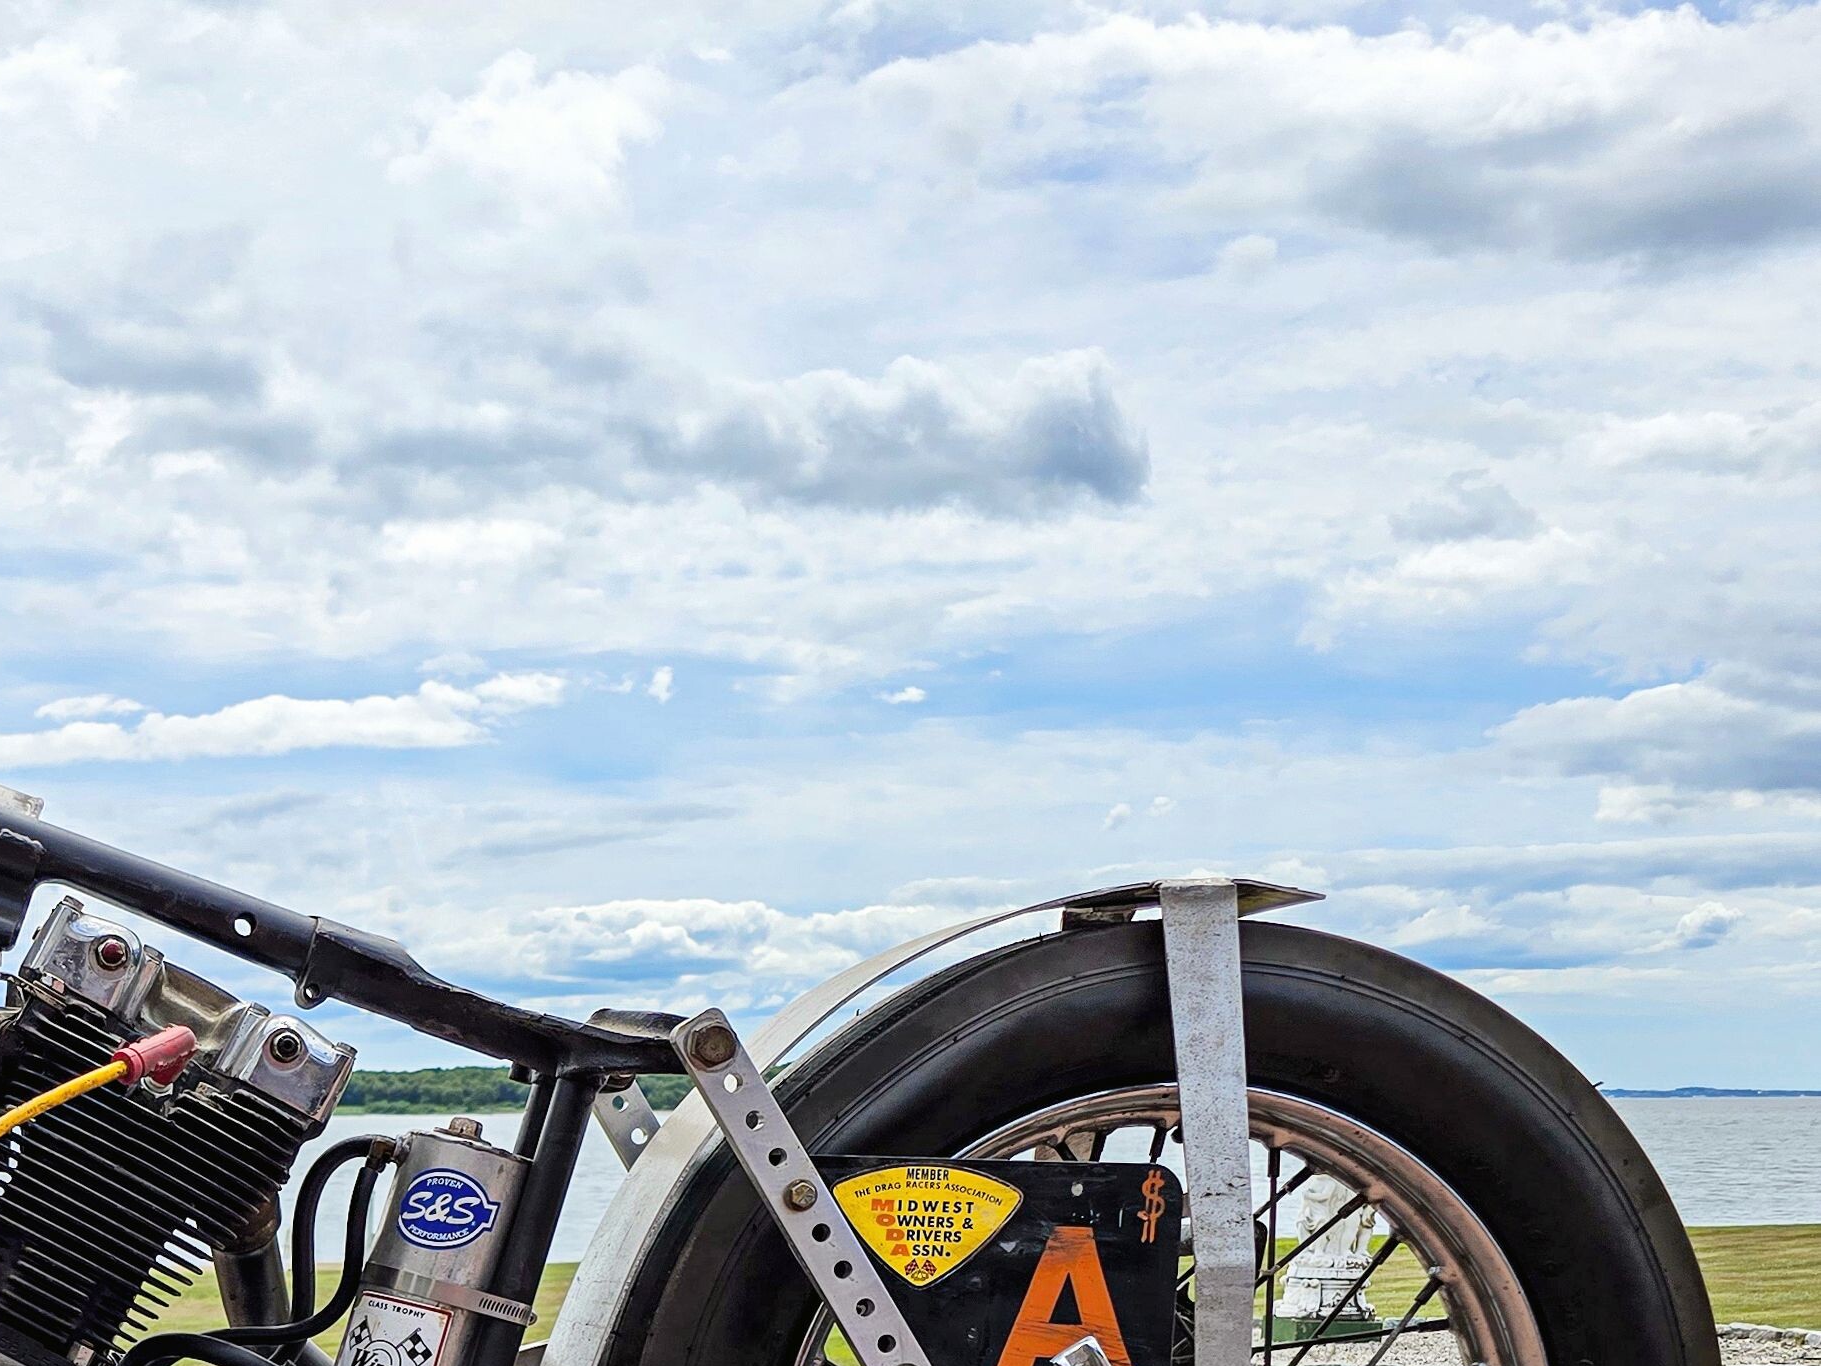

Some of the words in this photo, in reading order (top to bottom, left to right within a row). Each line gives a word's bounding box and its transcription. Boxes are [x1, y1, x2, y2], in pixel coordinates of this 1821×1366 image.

[905, 1168, 949, 1181] MEMBER
[426, 1177, 464, 1190] PROVEN
[854, 1186, 871, 1198] THE
[874, 1182, 901, 1193] DRAG
[905, 1181, 941, 1190] RACERS
[944, 1183, 1003, 1206] ASSOCIATION
[401, 1191, 481, 1225] S&S
[871, 1198, 974, 1214] MIDWEST
[875, 1213, 954, 1229] OWNERS
[961, 1217, 974, 1230] &
[407, 1223, 470, 1241] PERFORMANCE
[885, 1228, 962, 1243] DRIVERS
[890, 1243, 951, 1258] ASSN.
[368, 1300, 389, 1311] CLASS
[392, 1305, 427, 1319] TROPHY
